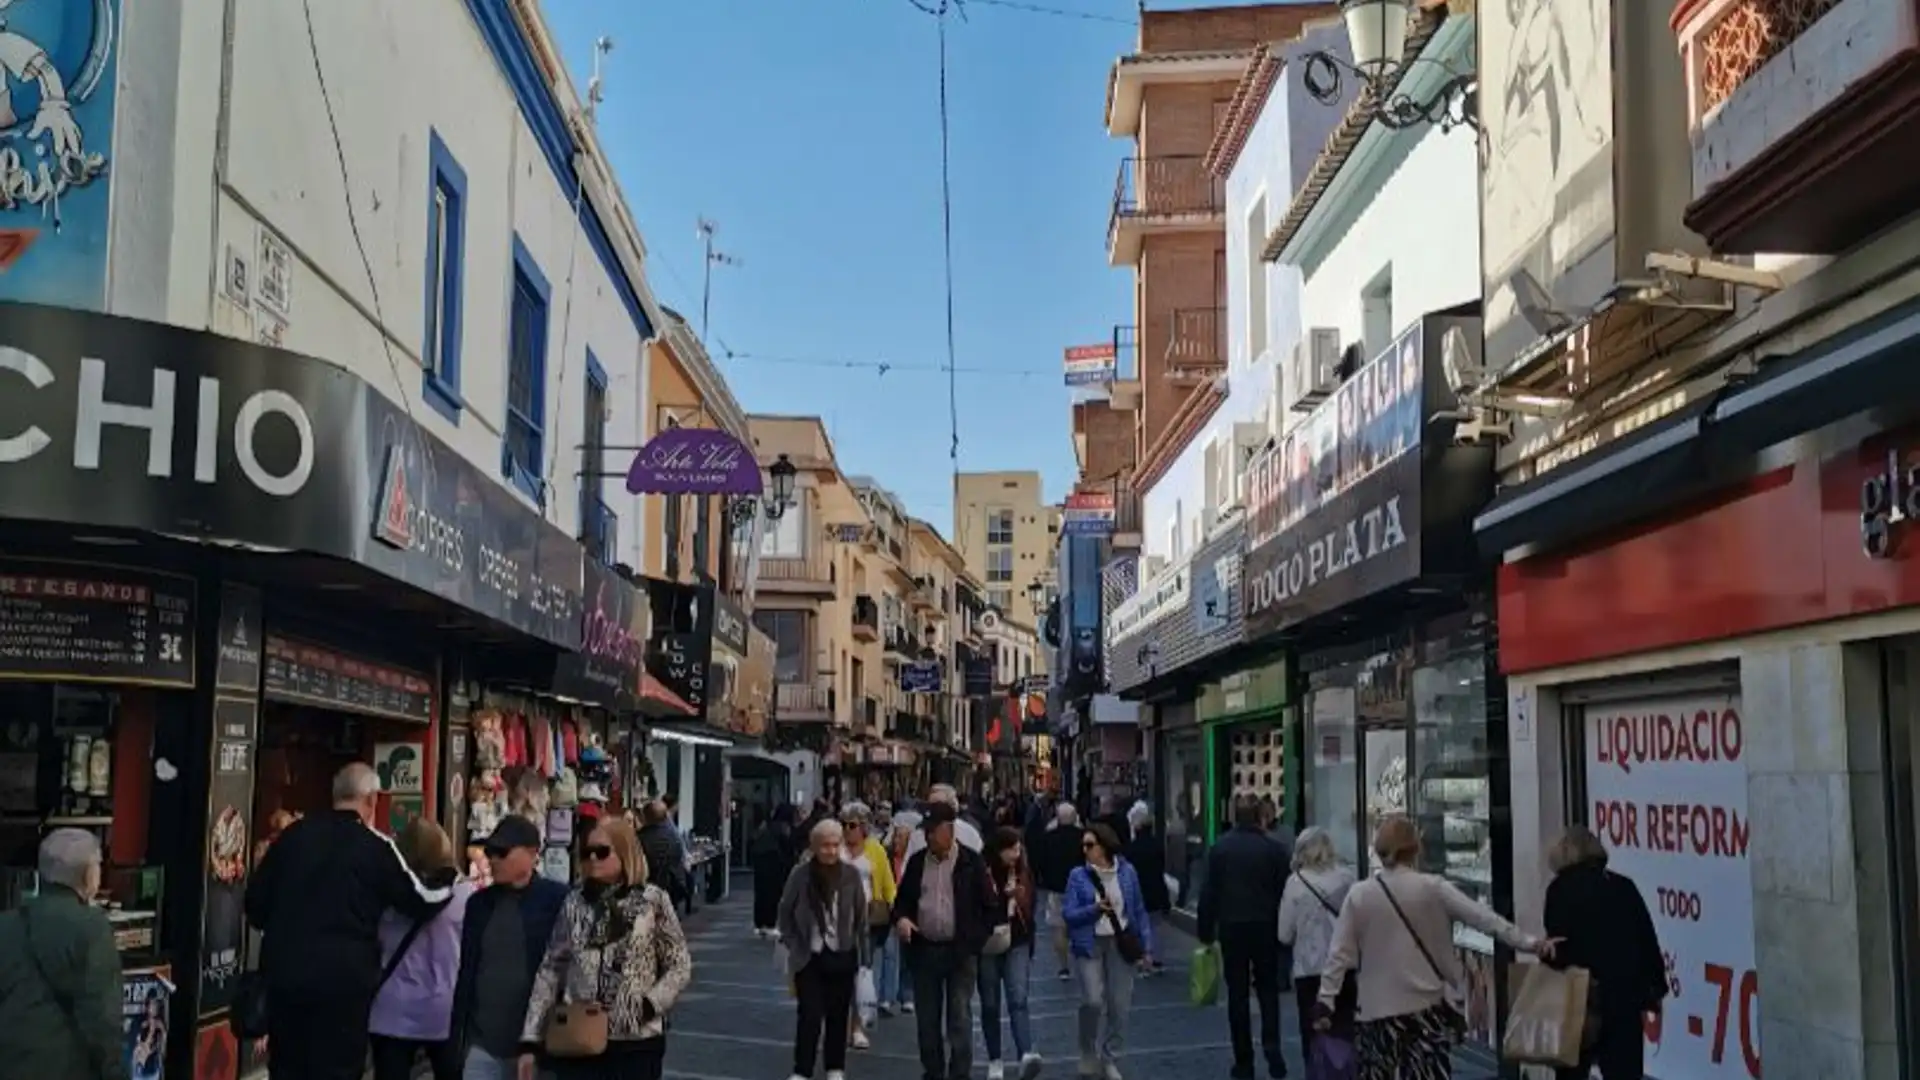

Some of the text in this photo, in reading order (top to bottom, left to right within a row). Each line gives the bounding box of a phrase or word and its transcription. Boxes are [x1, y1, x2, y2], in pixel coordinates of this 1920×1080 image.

[0, 344, 315, 497] CHIO
[1307, 495, 1406, 587] PLATA
[1594, 800, 1640, 849] POR
[1657, 887, 1701, 922] TODO
